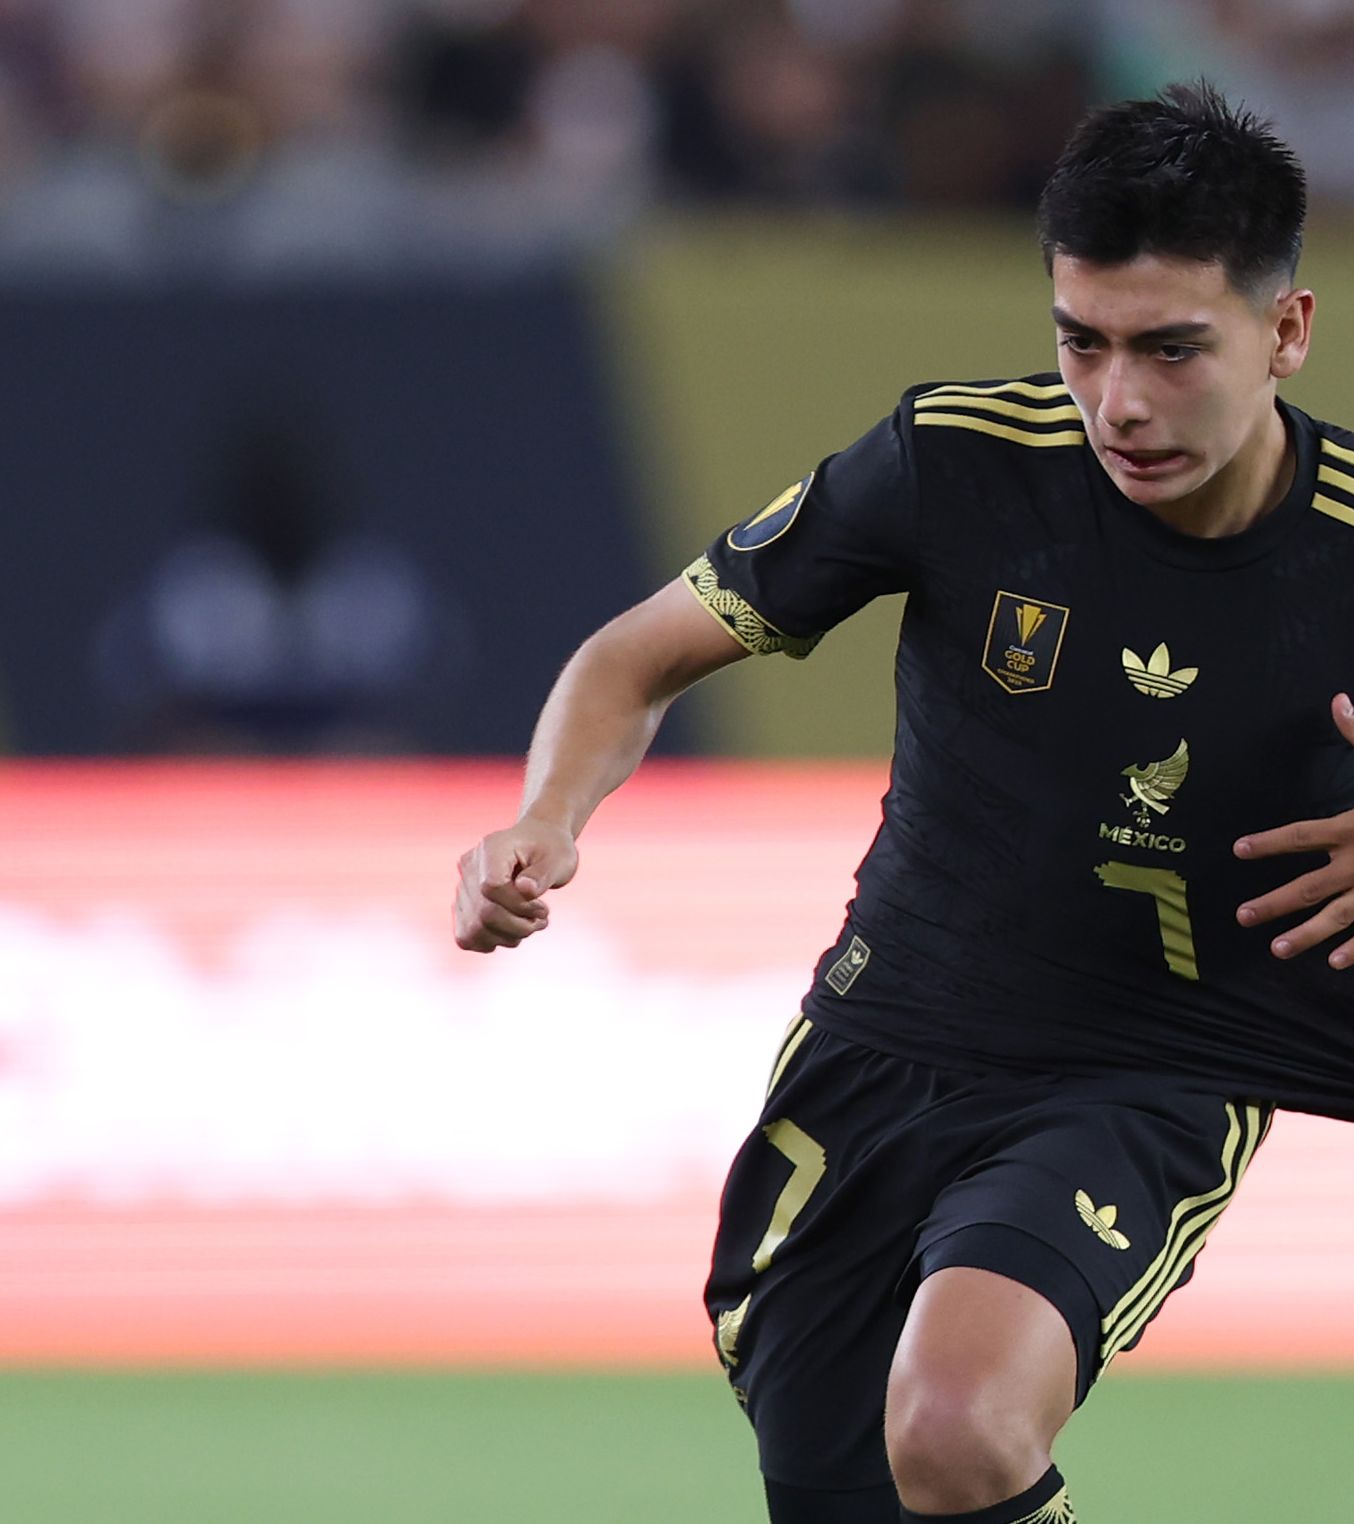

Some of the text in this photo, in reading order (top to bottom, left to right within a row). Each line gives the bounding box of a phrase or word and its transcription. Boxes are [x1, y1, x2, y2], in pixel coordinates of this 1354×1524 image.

[1004, 650, 1036, 666] GOLD
[1006, 660, 1030, 673] CUP
[1098, 822, 1187, 853] MÉXICO
[1093, 861, 1200, 980] 7
[752, 1117, 827, 1274] 7
